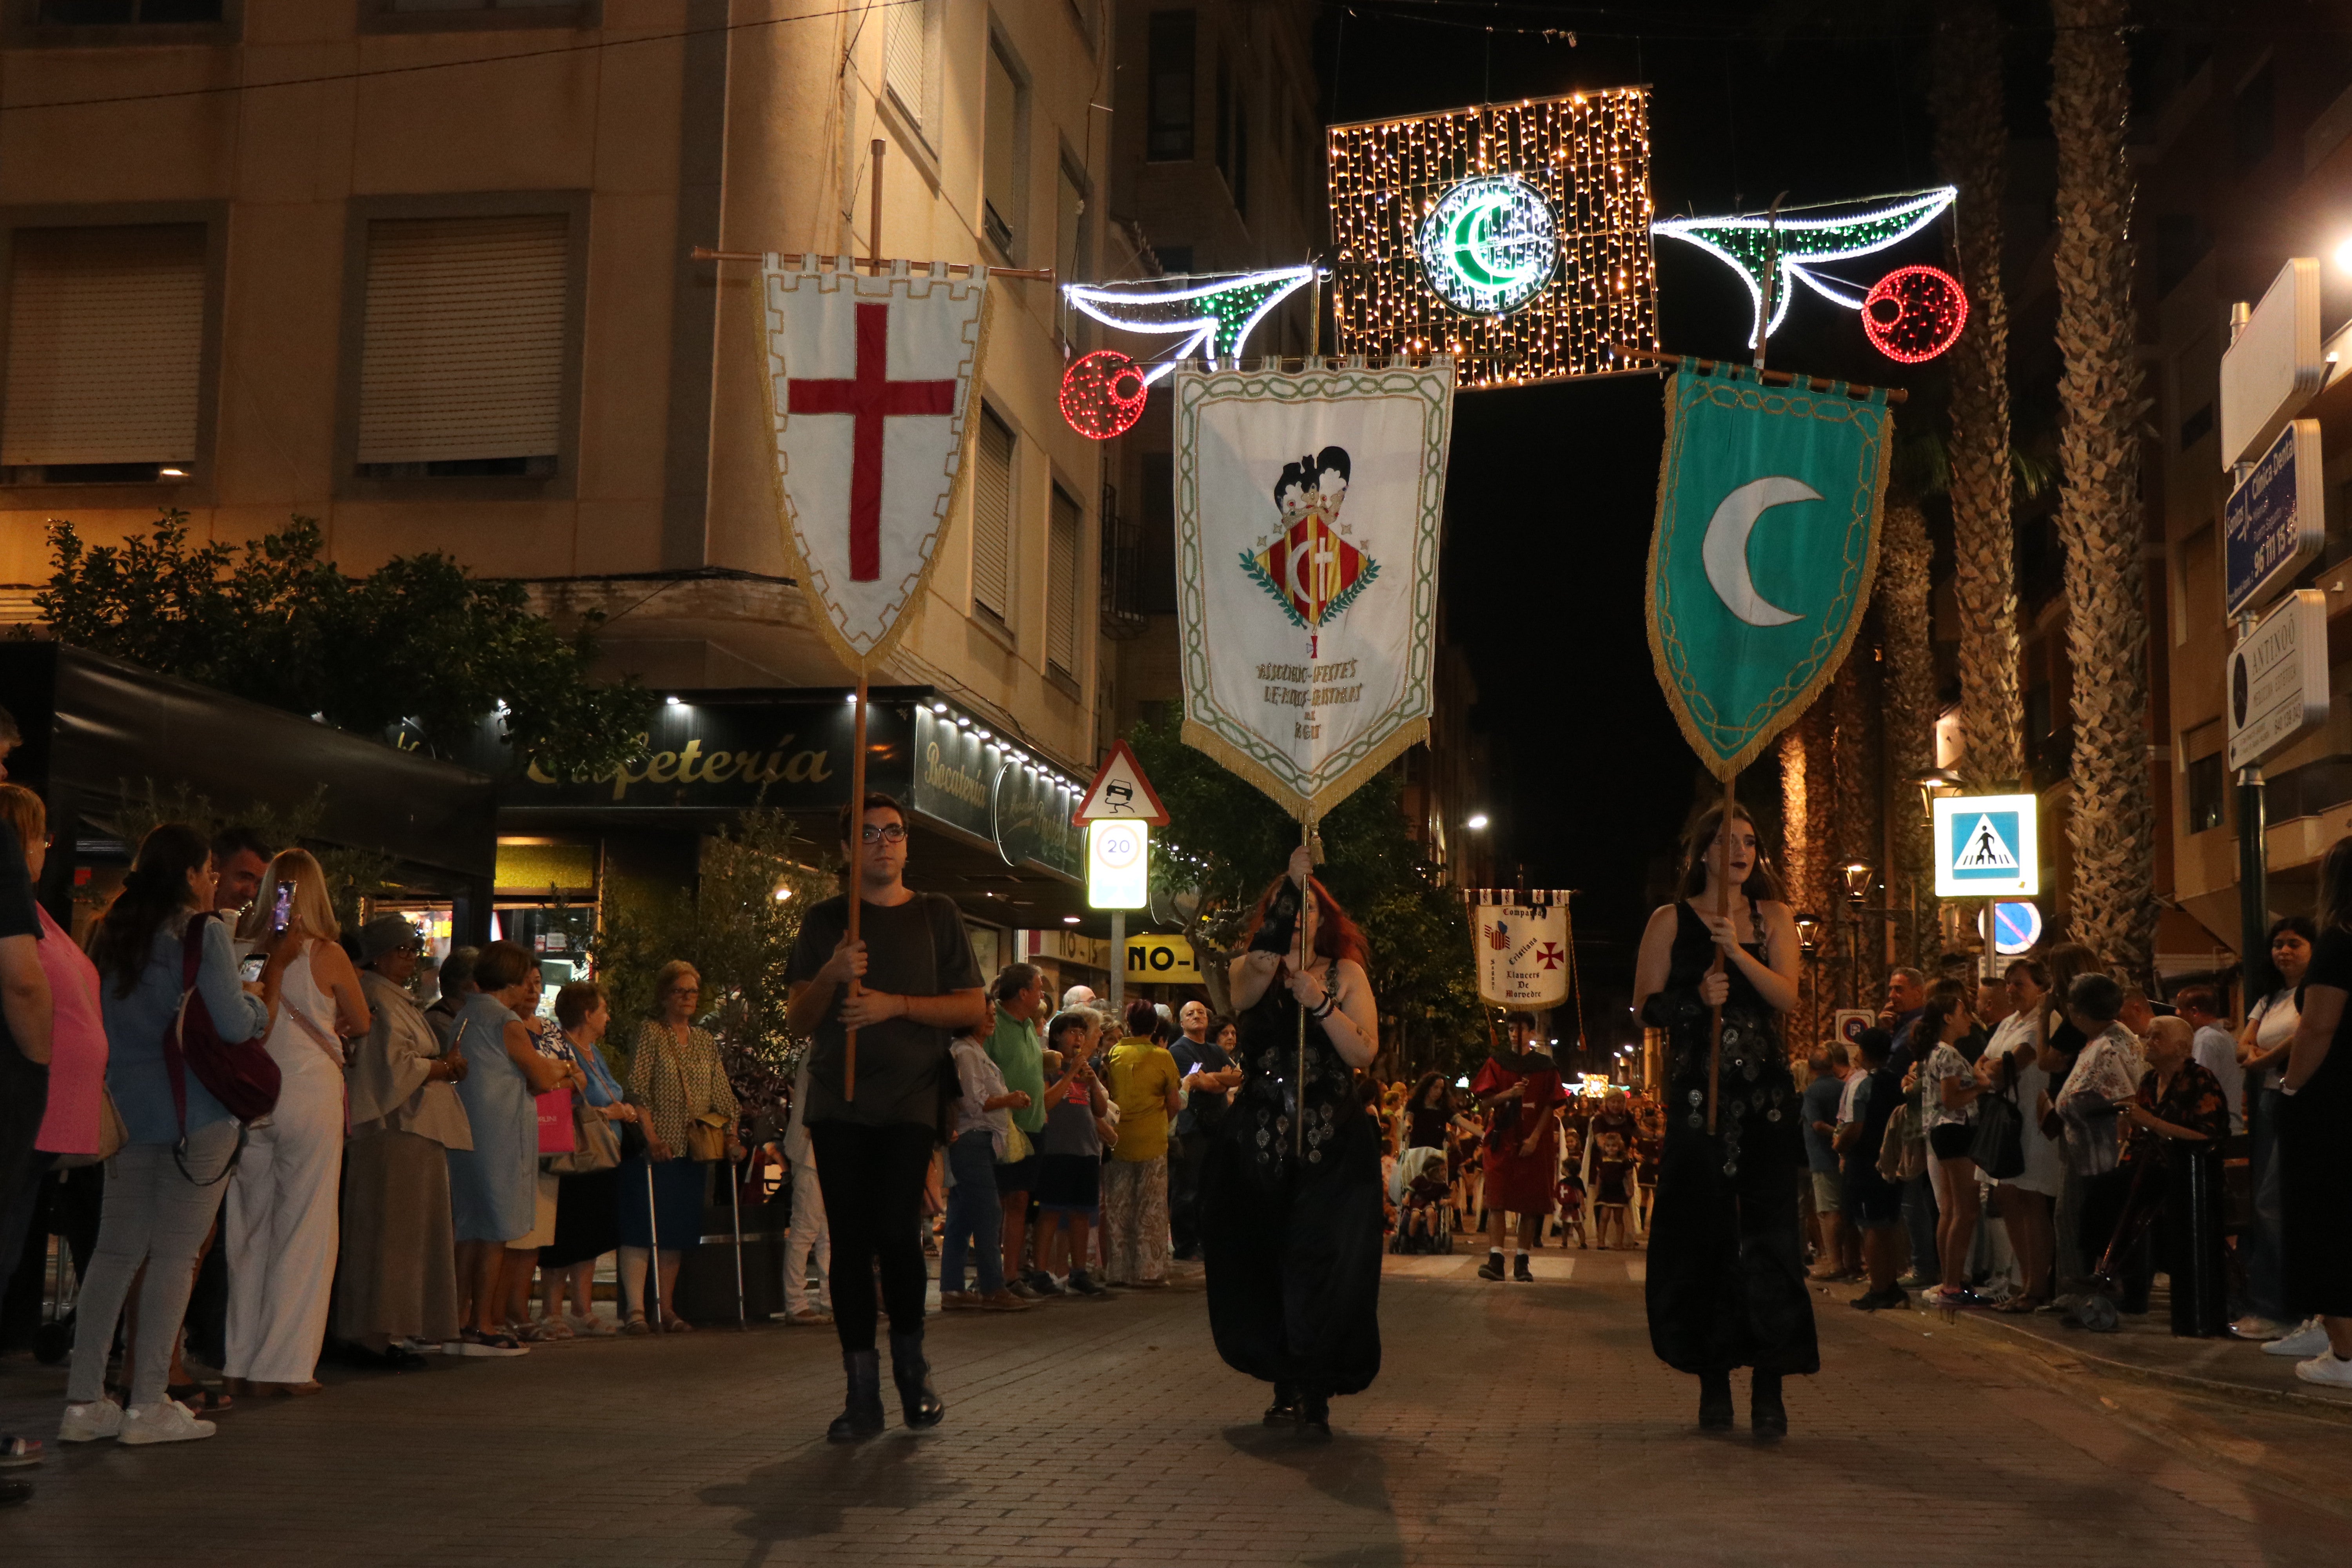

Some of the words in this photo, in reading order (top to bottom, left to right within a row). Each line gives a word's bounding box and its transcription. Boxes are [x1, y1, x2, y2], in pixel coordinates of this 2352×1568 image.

[2273, 439, 2293, 476] Denta
[2254, 545, 2265, 578] 96
[2266, 534, 2275, 566] 111
[2277, 523, 2286, 555] 15
[925, 742, 986, 809] Bocatería
[1107, 840, 1130, 853] 20
[1503, 908, 1542, 918] Compara
[1128, 946, 1216, 971] NO-I
[1509, 938, 1537, 965] Cristiana
